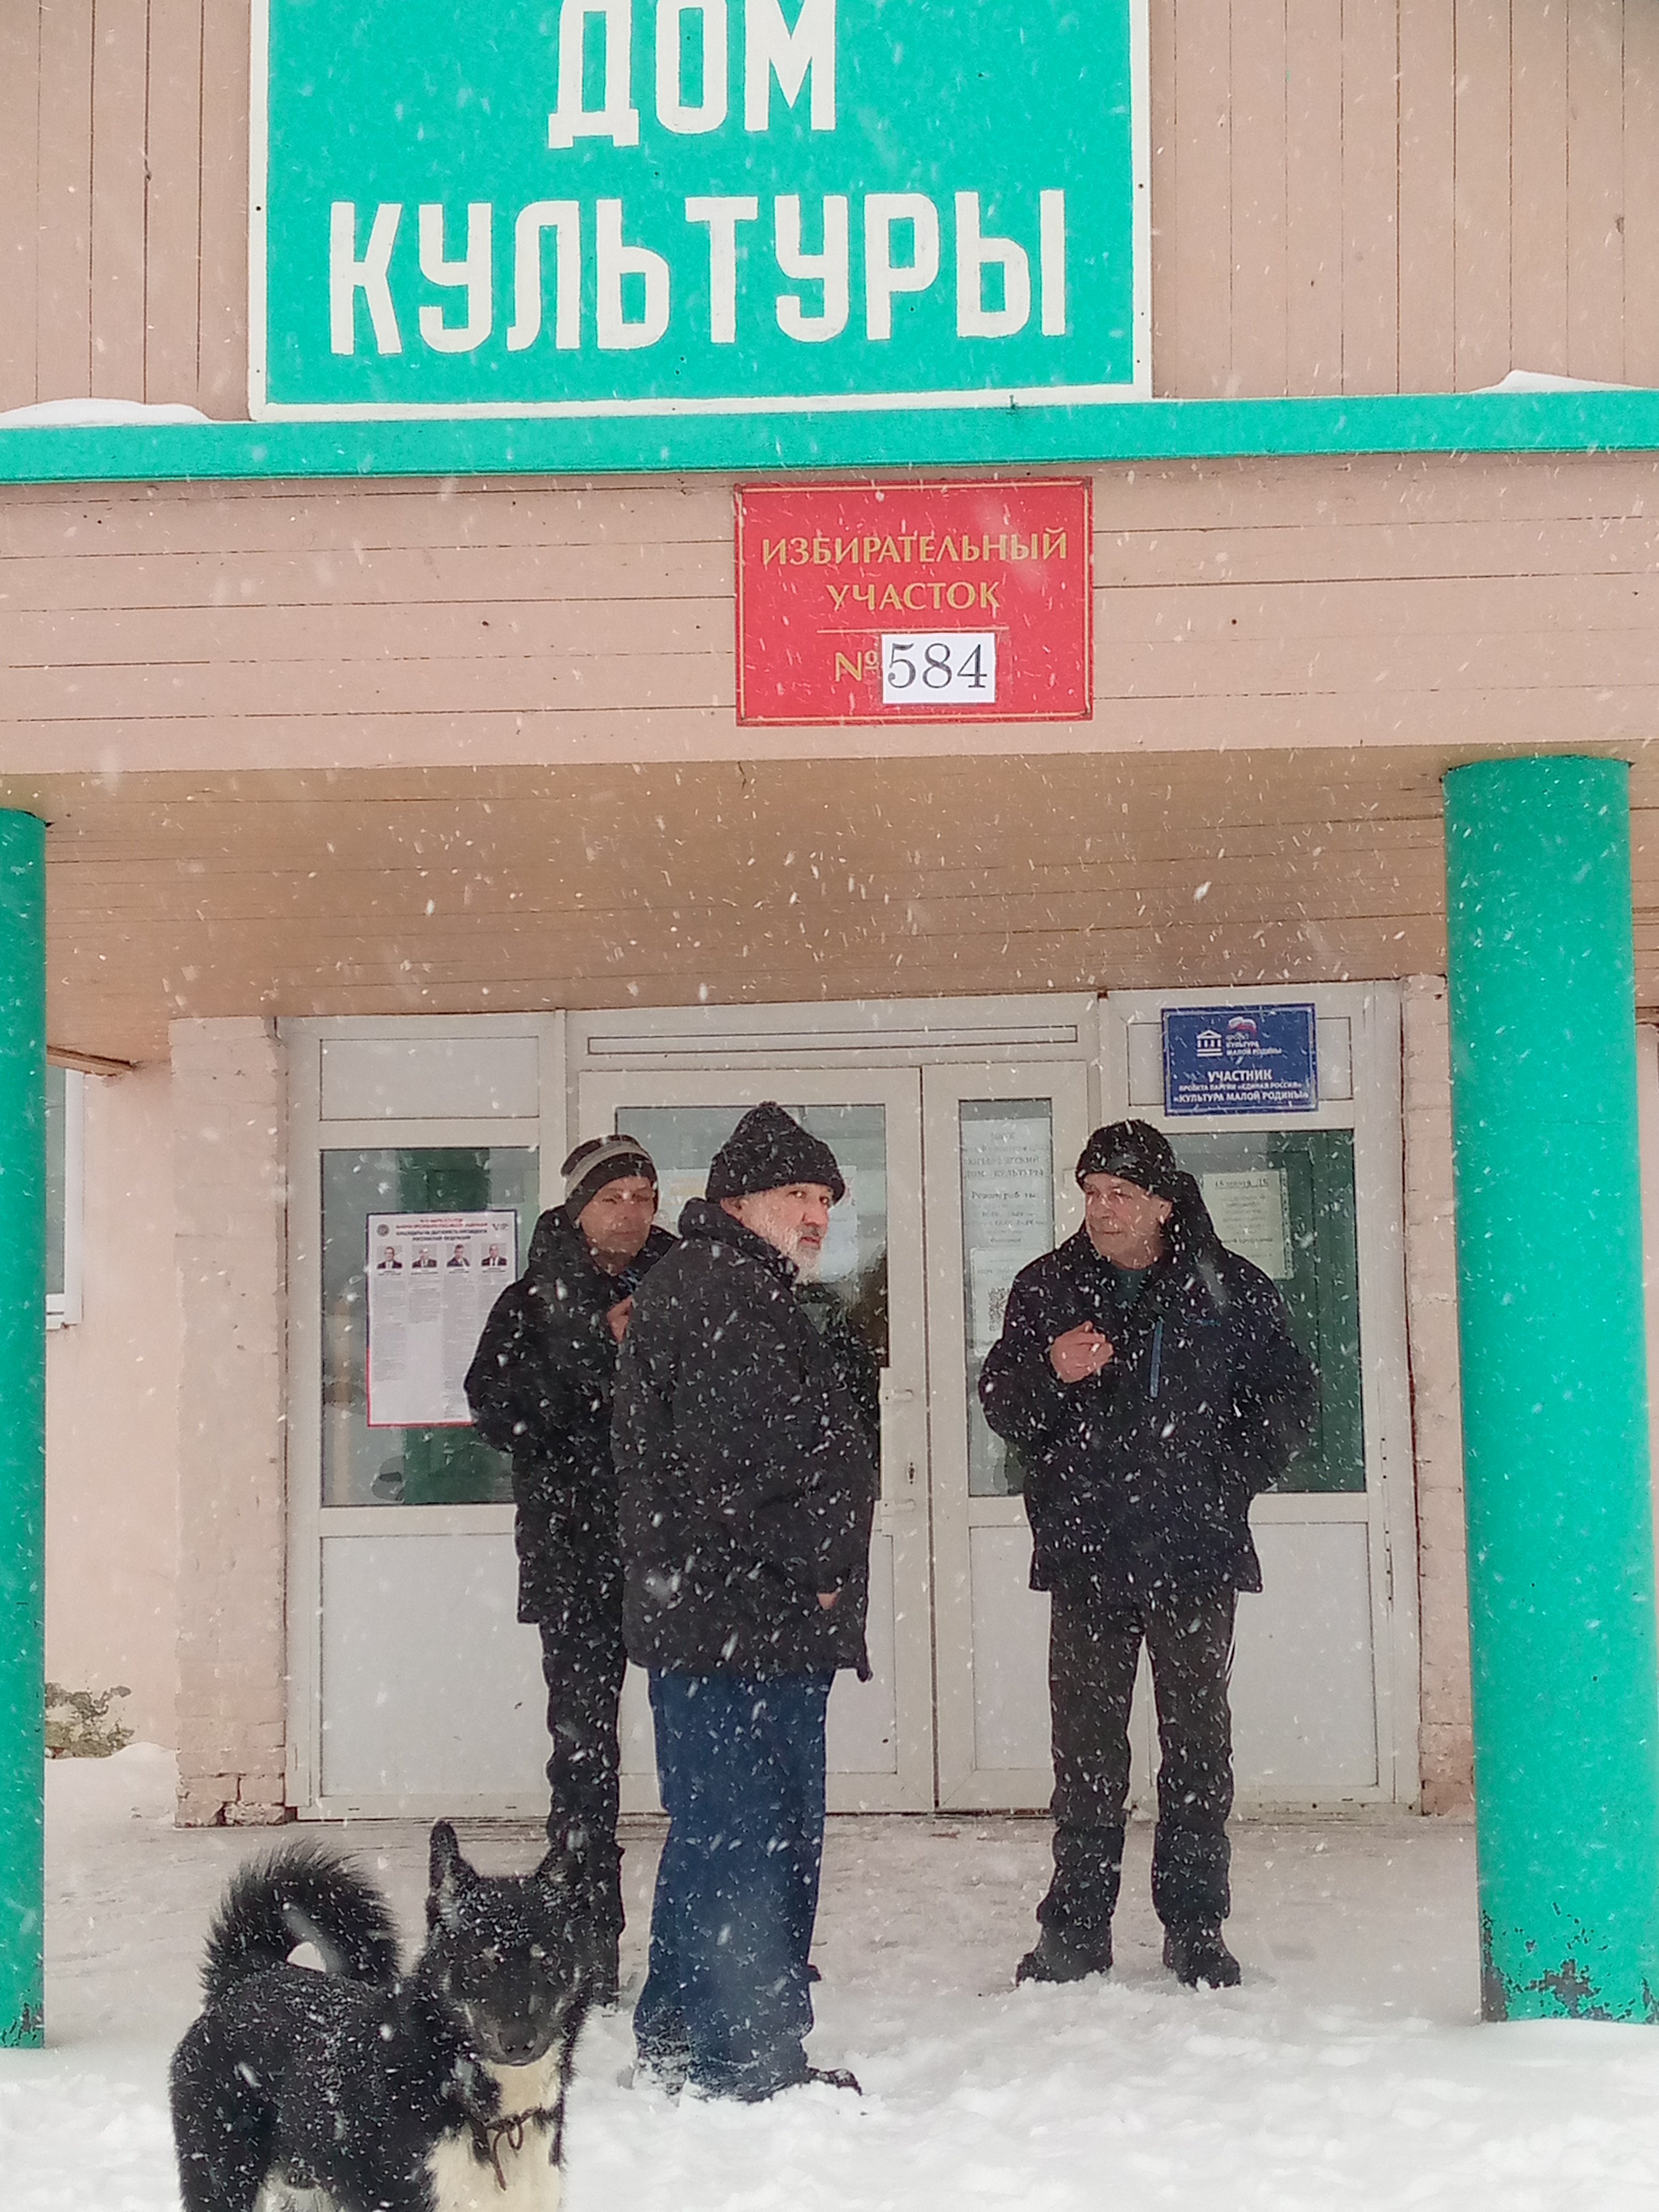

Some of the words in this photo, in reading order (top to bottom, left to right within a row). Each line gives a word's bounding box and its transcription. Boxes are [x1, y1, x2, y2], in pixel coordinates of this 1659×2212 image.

[548, 0, 837, 148] ДОМ
[329, 189, 1067, 355] КУЛЬТУРЫ
[763, 527, 1067, 565] ИЗБИРАТЕЛЬНЫЙ
[827, 582, 1001, 610] УЧАСТОК
[887, 643, 987, 689] 584
[1208, 1069, 1272, 1082] УЧАСТНИК
[1174, 1093, 1224, 1102] «КУЛЬТУРА
[1226, 1091, 1260, 1101] МАЛОЙ
[1262, 1090, 1309, 1101] РОДИНЫ»
